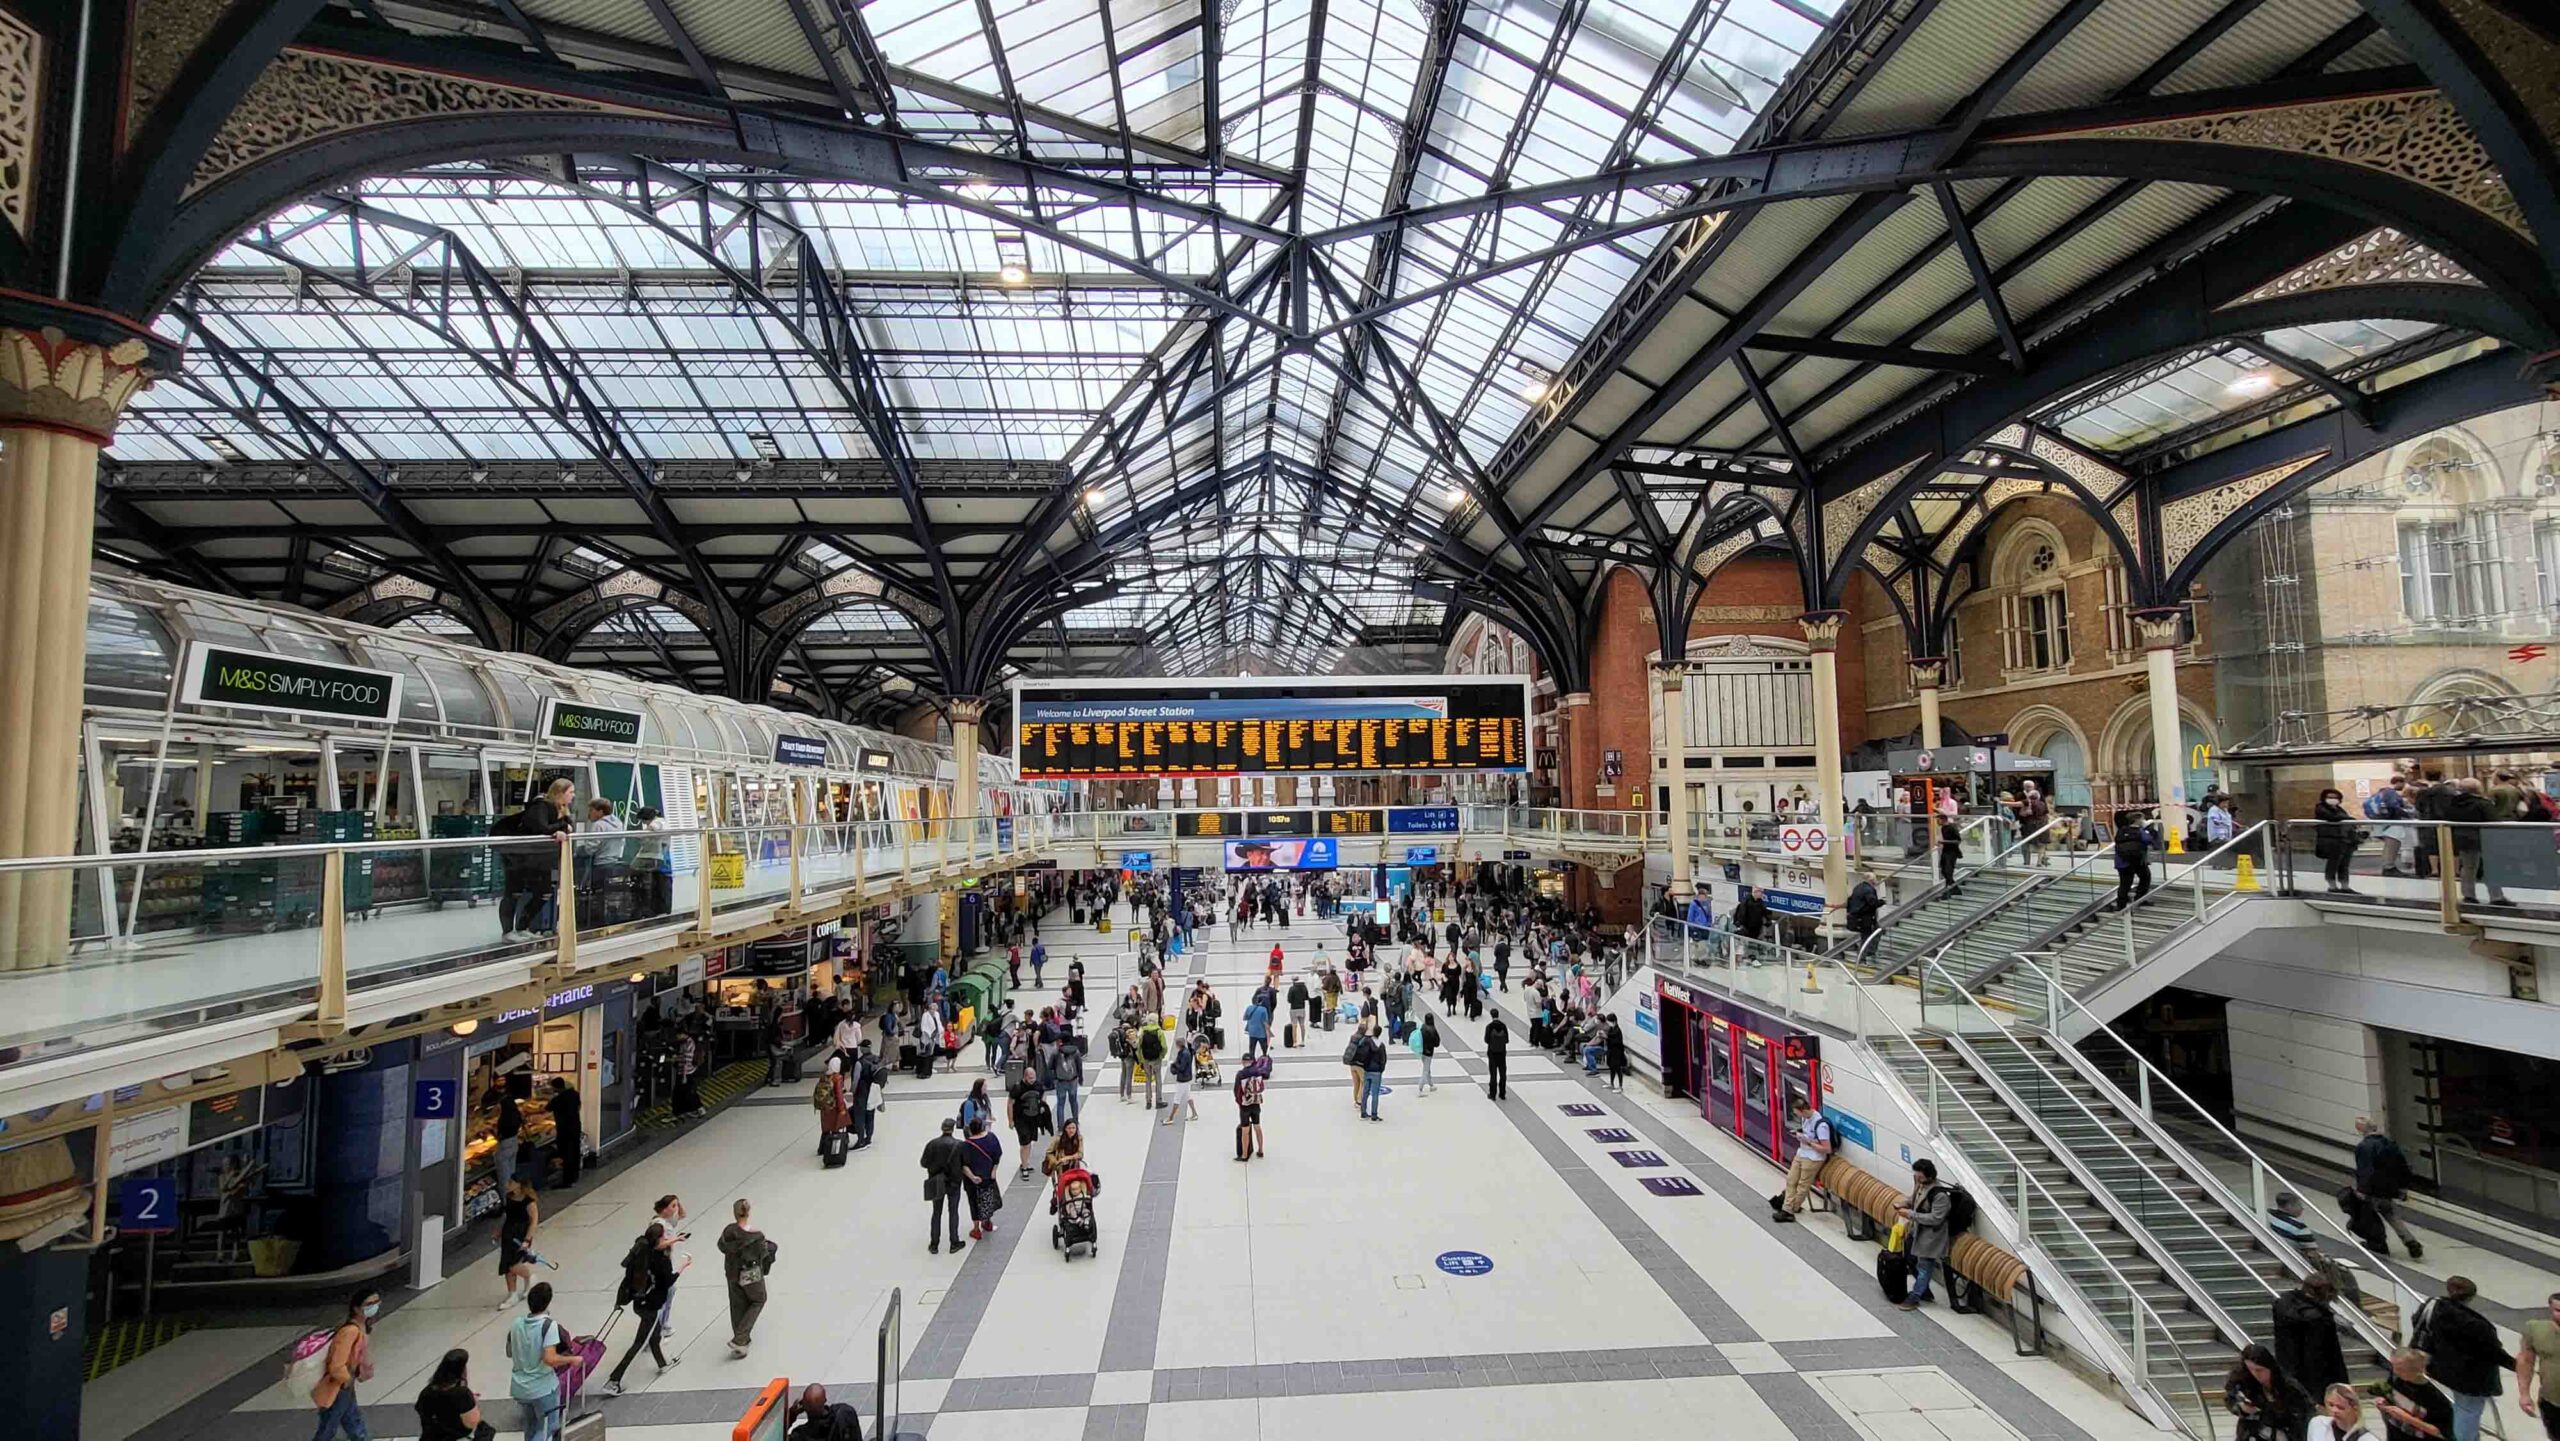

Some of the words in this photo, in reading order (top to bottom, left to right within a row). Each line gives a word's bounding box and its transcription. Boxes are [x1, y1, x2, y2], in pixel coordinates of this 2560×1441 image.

[218, 666, 266, 691] M&S
[268, 673, 331, 698] SIMPLY
[331, 682, 380, 704] FOOD
[558, 713, 581, 729] M&S
[581, 716, 610, 732] SIMPLY
[609, 720, 635, 735] FOOD
[1037, 709, 1071, 718] Welcome
[1072, 710, 1081, 718] to
[1082, 707, 1126, 720] Liverpool
[1127, 707, 1157, 717] Street
[1159, 706, 1194, 717] Station
[612, 800, 641, 827] &S
[1424, 811, 1436, 819] Lift
[1408, 821, 1429, 829] Toilets
[969, 894, 976, 903] 6
[1770, 895, 1789, 906] STREET
[816, 919, 841, 938] COFFEE
[552, 984, 594, 1008] France
[1663, 981, 1691, 1004] NatWest
[426, 1087, 442, 1111] 3
[137, 1188, 160, 1219] 2
